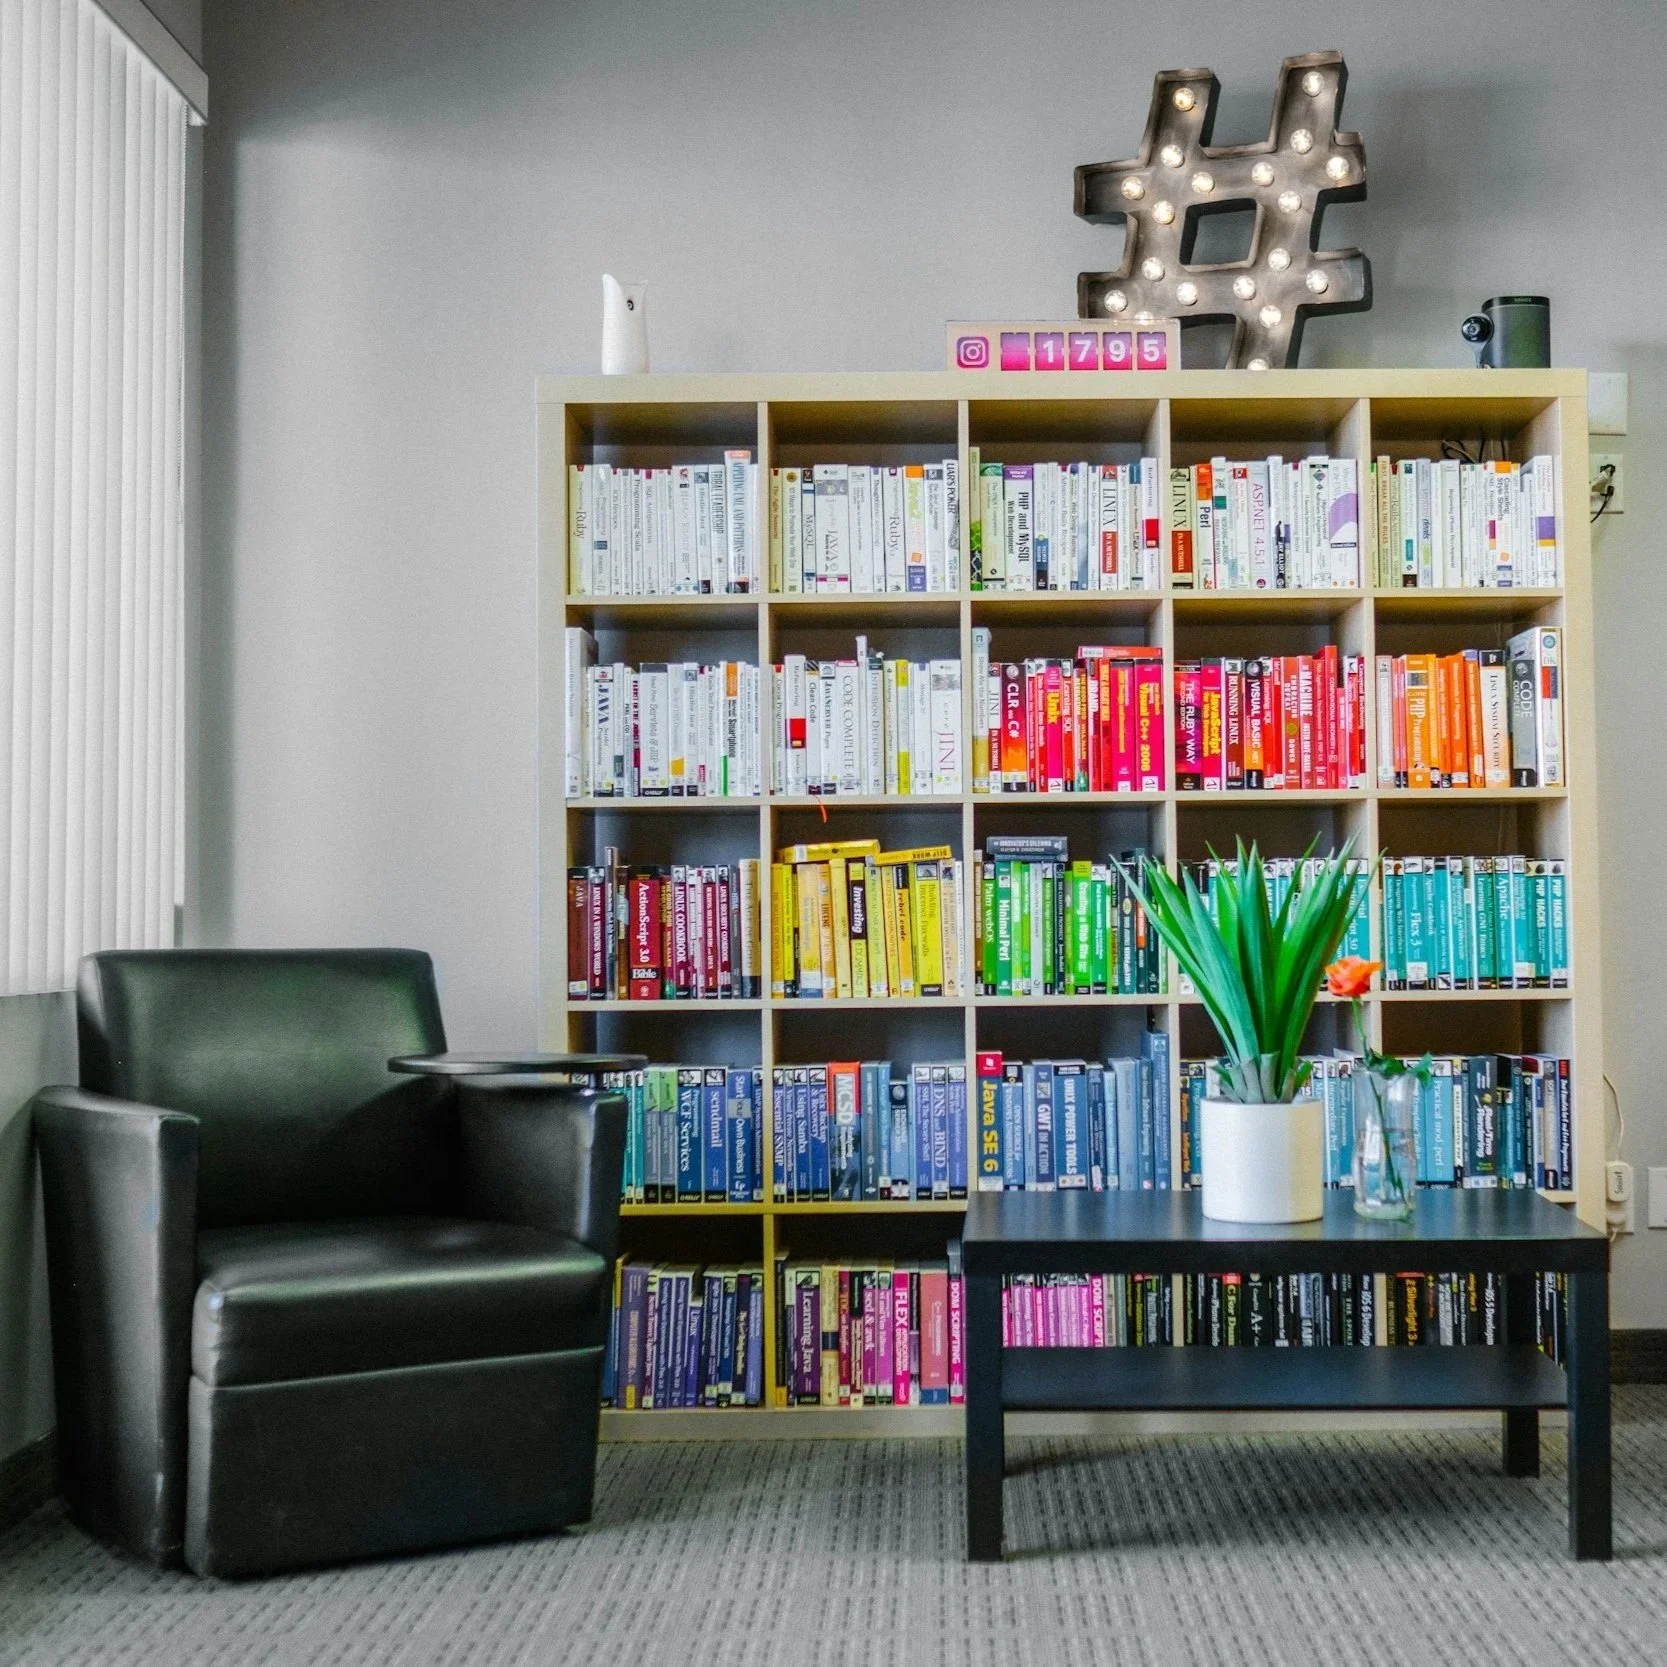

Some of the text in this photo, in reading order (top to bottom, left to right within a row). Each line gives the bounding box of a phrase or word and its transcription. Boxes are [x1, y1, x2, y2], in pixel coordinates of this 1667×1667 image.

[1042, 340, 1161, 363] 1795
[633, 479, 641, 529] Programming
[711, 471, 724, 534] TRIBAL LEADERSHIP
[733, 462, 745, 553] APPLYING UML AND PATTERNS
[946, 463, 957, 514] LIAR'S POKER
[1103, 488, 1116, 526] LINUX
[1173, 485, 1187, 527] LINUX
[573, 511, 587, 539] Ruby
[805, 514, 814, 549] MySQL
[887, 516, 901, 550] Ruby
[1006, 516, 1015, 554] Development
[1016, 492, 1029, 563] PHP and MySQL
[1200, 507, 1211, 528] Perl
[1253, 483, 1265, 565] ASP.NET 4.5.1
[829, 530, 838, 561] JAVA
[1060, 529, 1068, 556] Recipes
[979, 675, 985, 685] Me
[1007, 683, 1019, 707] CLR
[1089, 680, 1098, 712] BRAND
[1300, 671, 1312, 716] MACHINE
[1520, 680, 1532, 718] CODE
[598, 684, 609, 724] JAVA
[775, 702, 783, 748] Programming
[843, 675, 854, 769] CODE COMPLETE
[1047, 692, 1060, 725] Unix
[1063, 680, 1072, 733] Learning SQL
[1186, 682, 1195, 764] THE RUBY WAY
[1209, 692, 1221, 755] JavaScript
[1228, 675, 1239, 745] RUNNING LINUX
[1251, 682, 1261, 748] VISUAL BASIC
[1490, 675, 1500, 768] LINUX SYSTEM SECURITY
[727, 719, 737, 758] Smartphone
[1008, 720, 1020, 738] C#
[1409, 698, 1425, 761] PHP Programming
[575, 886, 583, 908] JAVA
[852, 886, 864, 933] Investing
[920, 884, 928, 918] Internet
[985, 883, 995, 943] Palm webOS
[1476, 878, 1487, 958] Learning GNU Emacs
[1496, 877, 1510, 919] Apache
[1536, 879, 1546, 927] PHP HACKS
[1553, 879, 1562, 928] PHP HACKS
[593, 921, 601, 951] WINDOWS
[637, 883, 650, 962] ActionScript 3.0
[675, 886, 686, 962] LINUX COOKBOOK
[999, 899, 1010, 961] Minimal Perl
[1411, 911, 1421, 936] Flex
[632, 968, 657, 979] Bible
[735, 1076, 744, 1098] Start
[837, 1075, 853, 1124] MCSD
[934, 1087, 944, 1117] DNS
[680, 1089, 691, 1172] WCF Services
[710, 1091, 722, 1148] sendmail
[736, 1118, 744, 1138] Own
[774, 1089, 783, 1166] Essential SNMP
[795, 1089, 807, 1153] Using Samba
[983, 1080, 998, 1172] Java SE 6
[1037, 1104, 1051, 1174] GWT IN ACTION
[1064, 1079, 1077, 1174] UNIX POWER TOOLS
[1476, 1108, 1484, 1157] Rendering
[1485, 1108, 1493, 1155] Real-Time
[736, 1139, 745, 1173] Business
[934, 1131, 945, 1168] BIND
[865, 1292, 875, 1352] sed & awk
[895, 1292, 907, 1327] FLEX
[1228, 1284, 1236, 1315] C For
[1405, 1287, 1417, 1332] Silverlight
[689, 1310, 700, 1336] Linux
[801, 1291, 814, 1373] Learning Java
[951, 1282, 961, 1364] DOM SCRIPTING
[1251, 1312, 1263, 1334] A+
